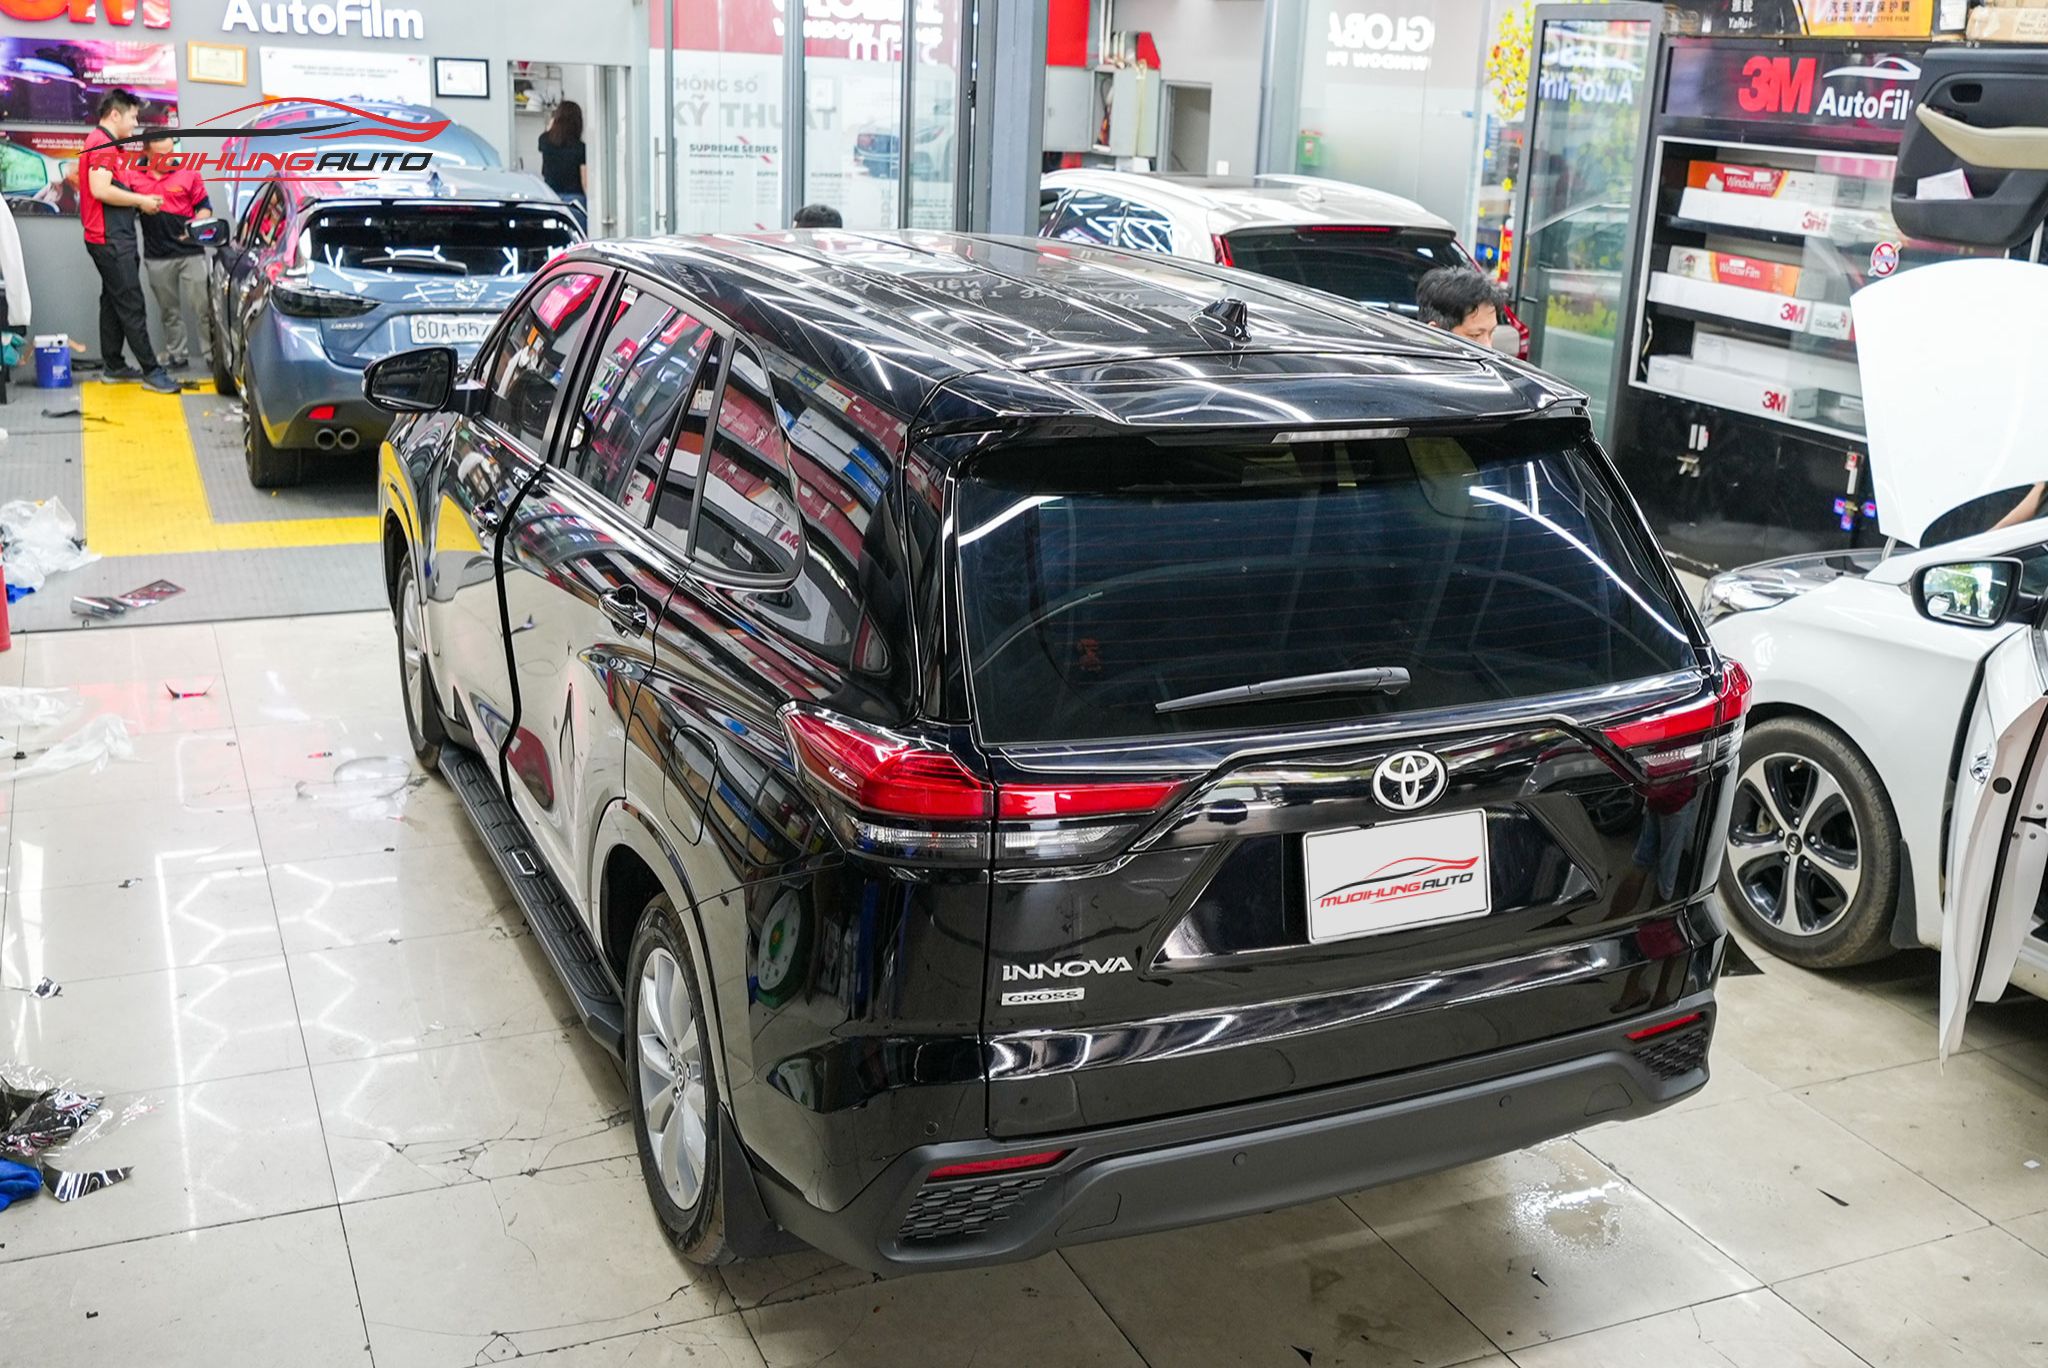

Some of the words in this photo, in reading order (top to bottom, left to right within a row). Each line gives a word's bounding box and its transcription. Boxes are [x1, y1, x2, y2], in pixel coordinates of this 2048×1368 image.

[222, 0, 424, 40] AutoFilm
[734, 75, 759, 93] SỐ
[1738, 56, 1816, 114] 3M
[1816, 87, 1913, 121] AutoFil
[689, 143, 739, 153] SUPREME
[742, 145, 778, 154] SERIES
[1725, 175, 1754, 190] Window
[1745, 266, 1760, 279] Film
[1780, 303, 1806, 325] 3M
[1762, 390, 1787, 414] 3M
[1002, 956, 1133, 981] INNOVA
[1008, 990, 1079, 1004] CROSS
